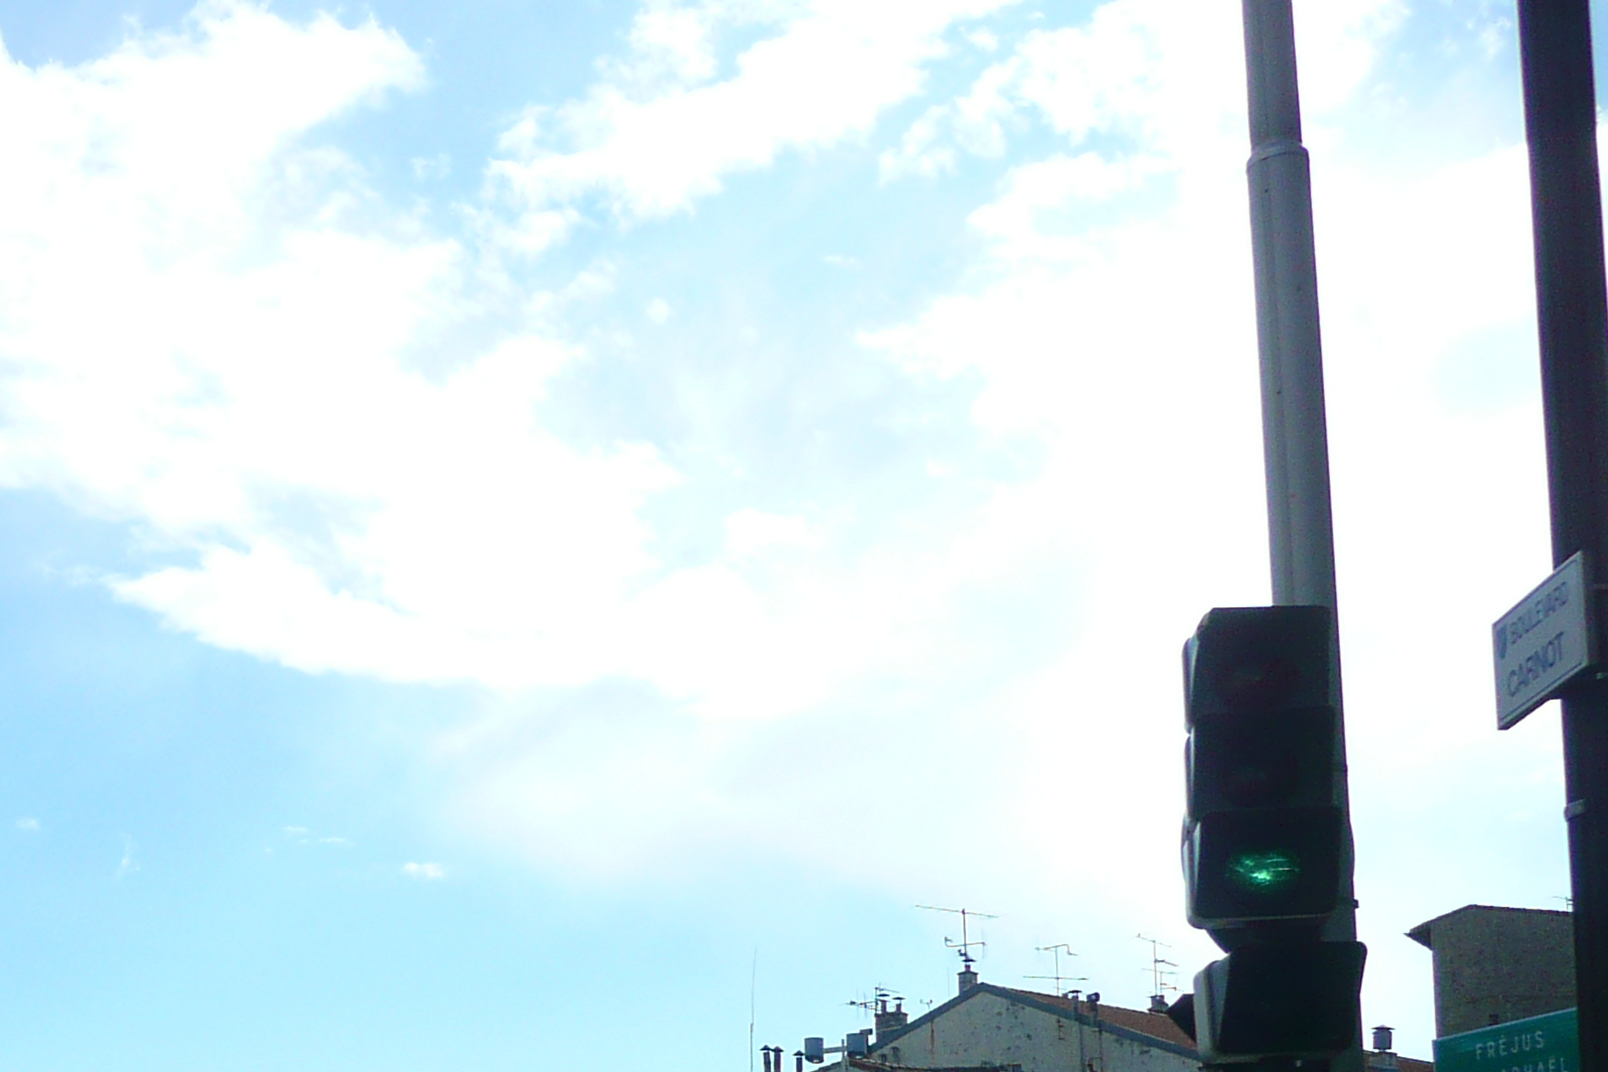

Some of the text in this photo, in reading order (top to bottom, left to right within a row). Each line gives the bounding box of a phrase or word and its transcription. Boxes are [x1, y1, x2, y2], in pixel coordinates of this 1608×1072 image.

[1510, 580, 1569, 645] BOULEVARD
[1507, 629, 1564, 698] CARNOT
[1475, 1030, 1545, 1060] FRÉJUS
